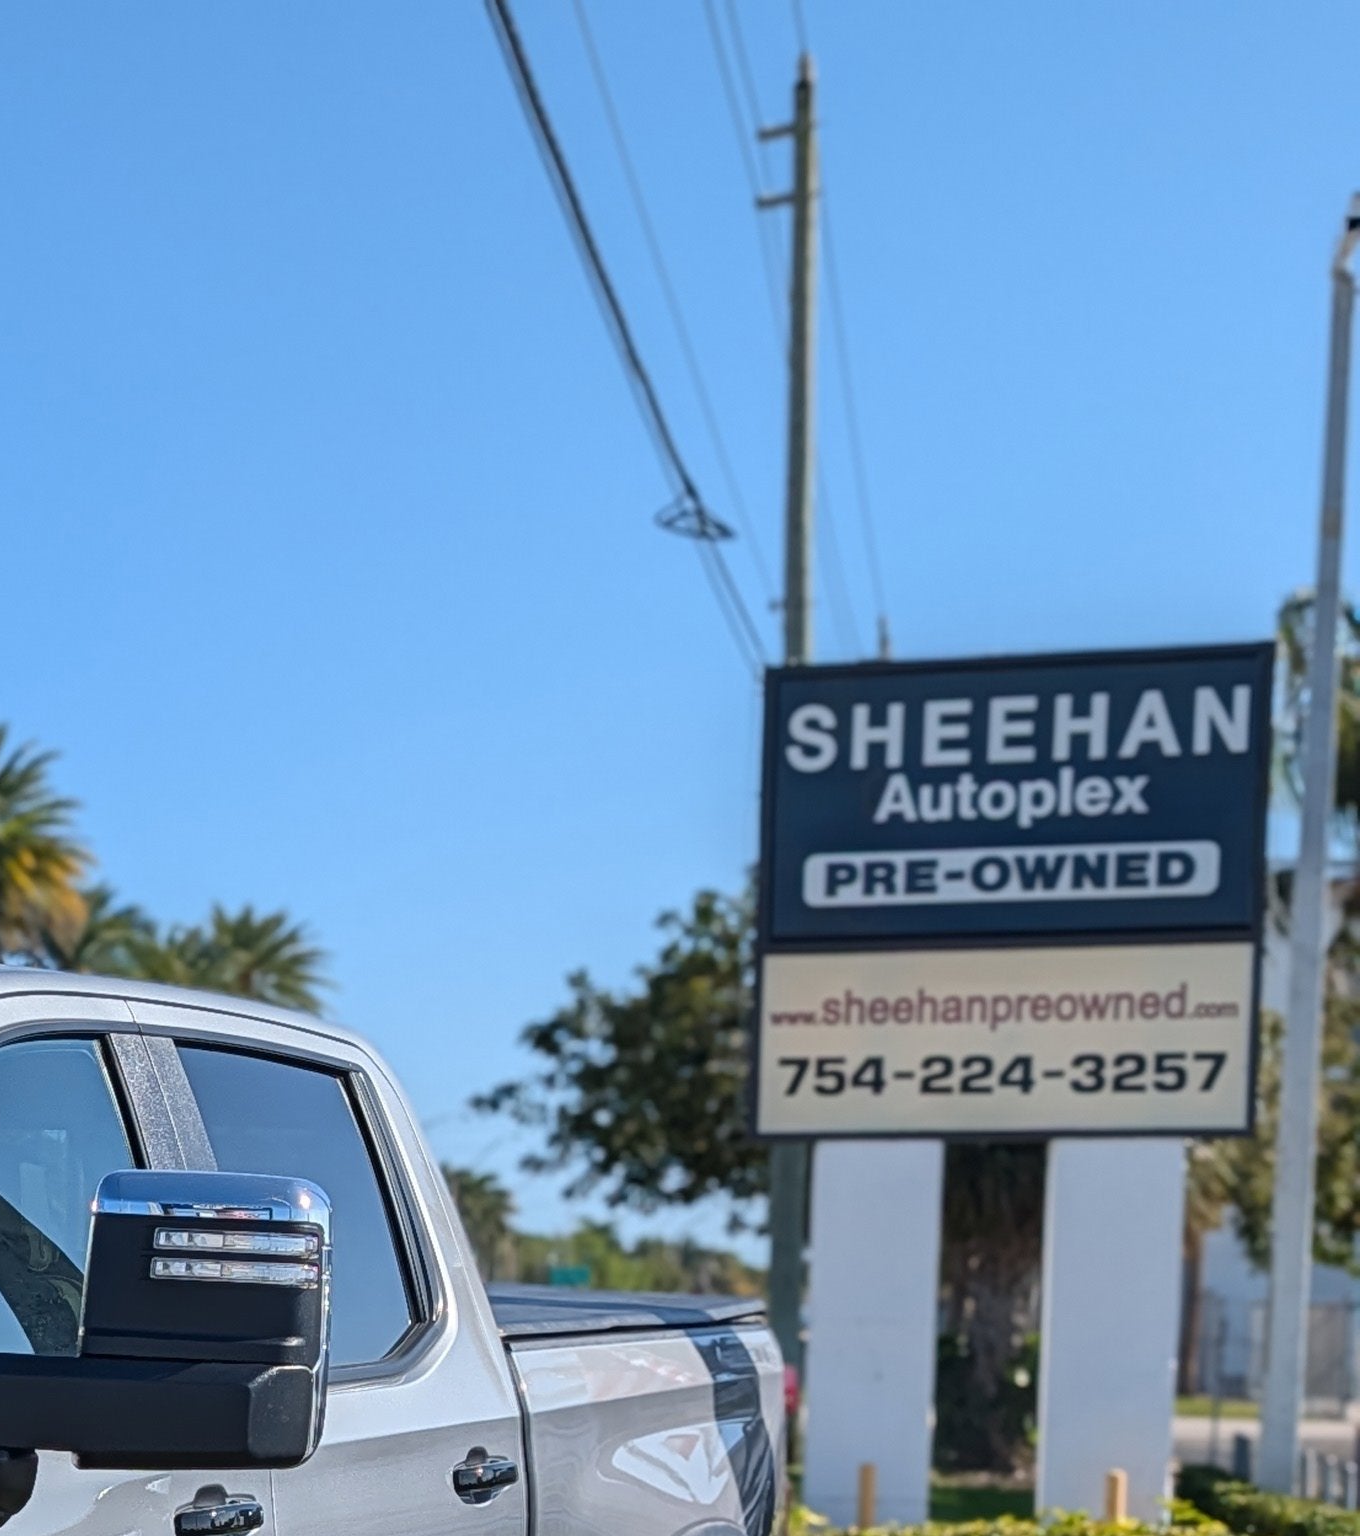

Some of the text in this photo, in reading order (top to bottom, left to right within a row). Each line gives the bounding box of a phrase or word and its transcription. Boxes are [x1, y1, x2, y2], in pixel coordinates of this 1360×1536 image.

[784, 685, 1252, 773] SHEEHAN
[873, 766, 1150, 829] Autoplex
[823, 850, 1197, 898] PRE-OWNED
[770, 982, 1240, 1032] www.sheehanpreowned.com
[778, 1052, 1228, 1097] 754-224-3257
